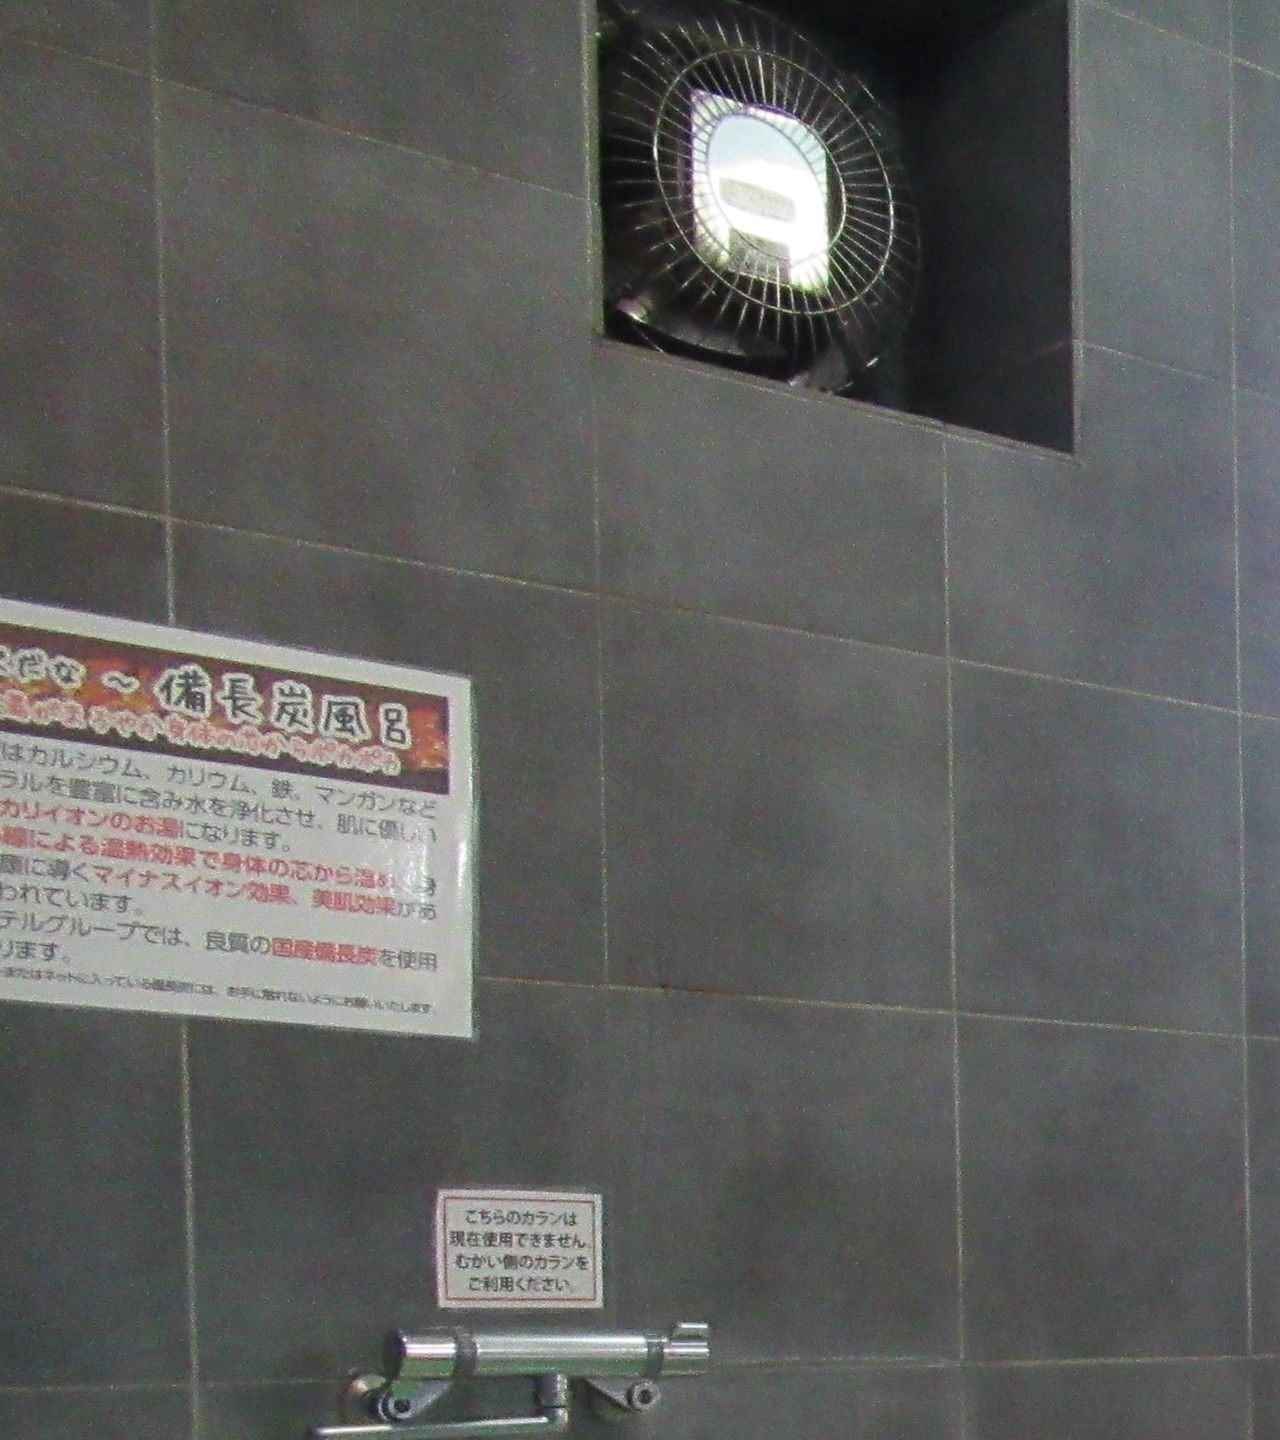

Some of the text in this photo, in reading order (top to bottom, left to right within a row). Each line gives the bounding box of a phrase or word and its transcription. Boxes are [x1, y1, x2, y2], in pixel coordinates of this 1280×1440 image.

[465, 1208, 578, 1227] こちらのカランは
[455, 1254, 589, 1271] むかい側のカランを
